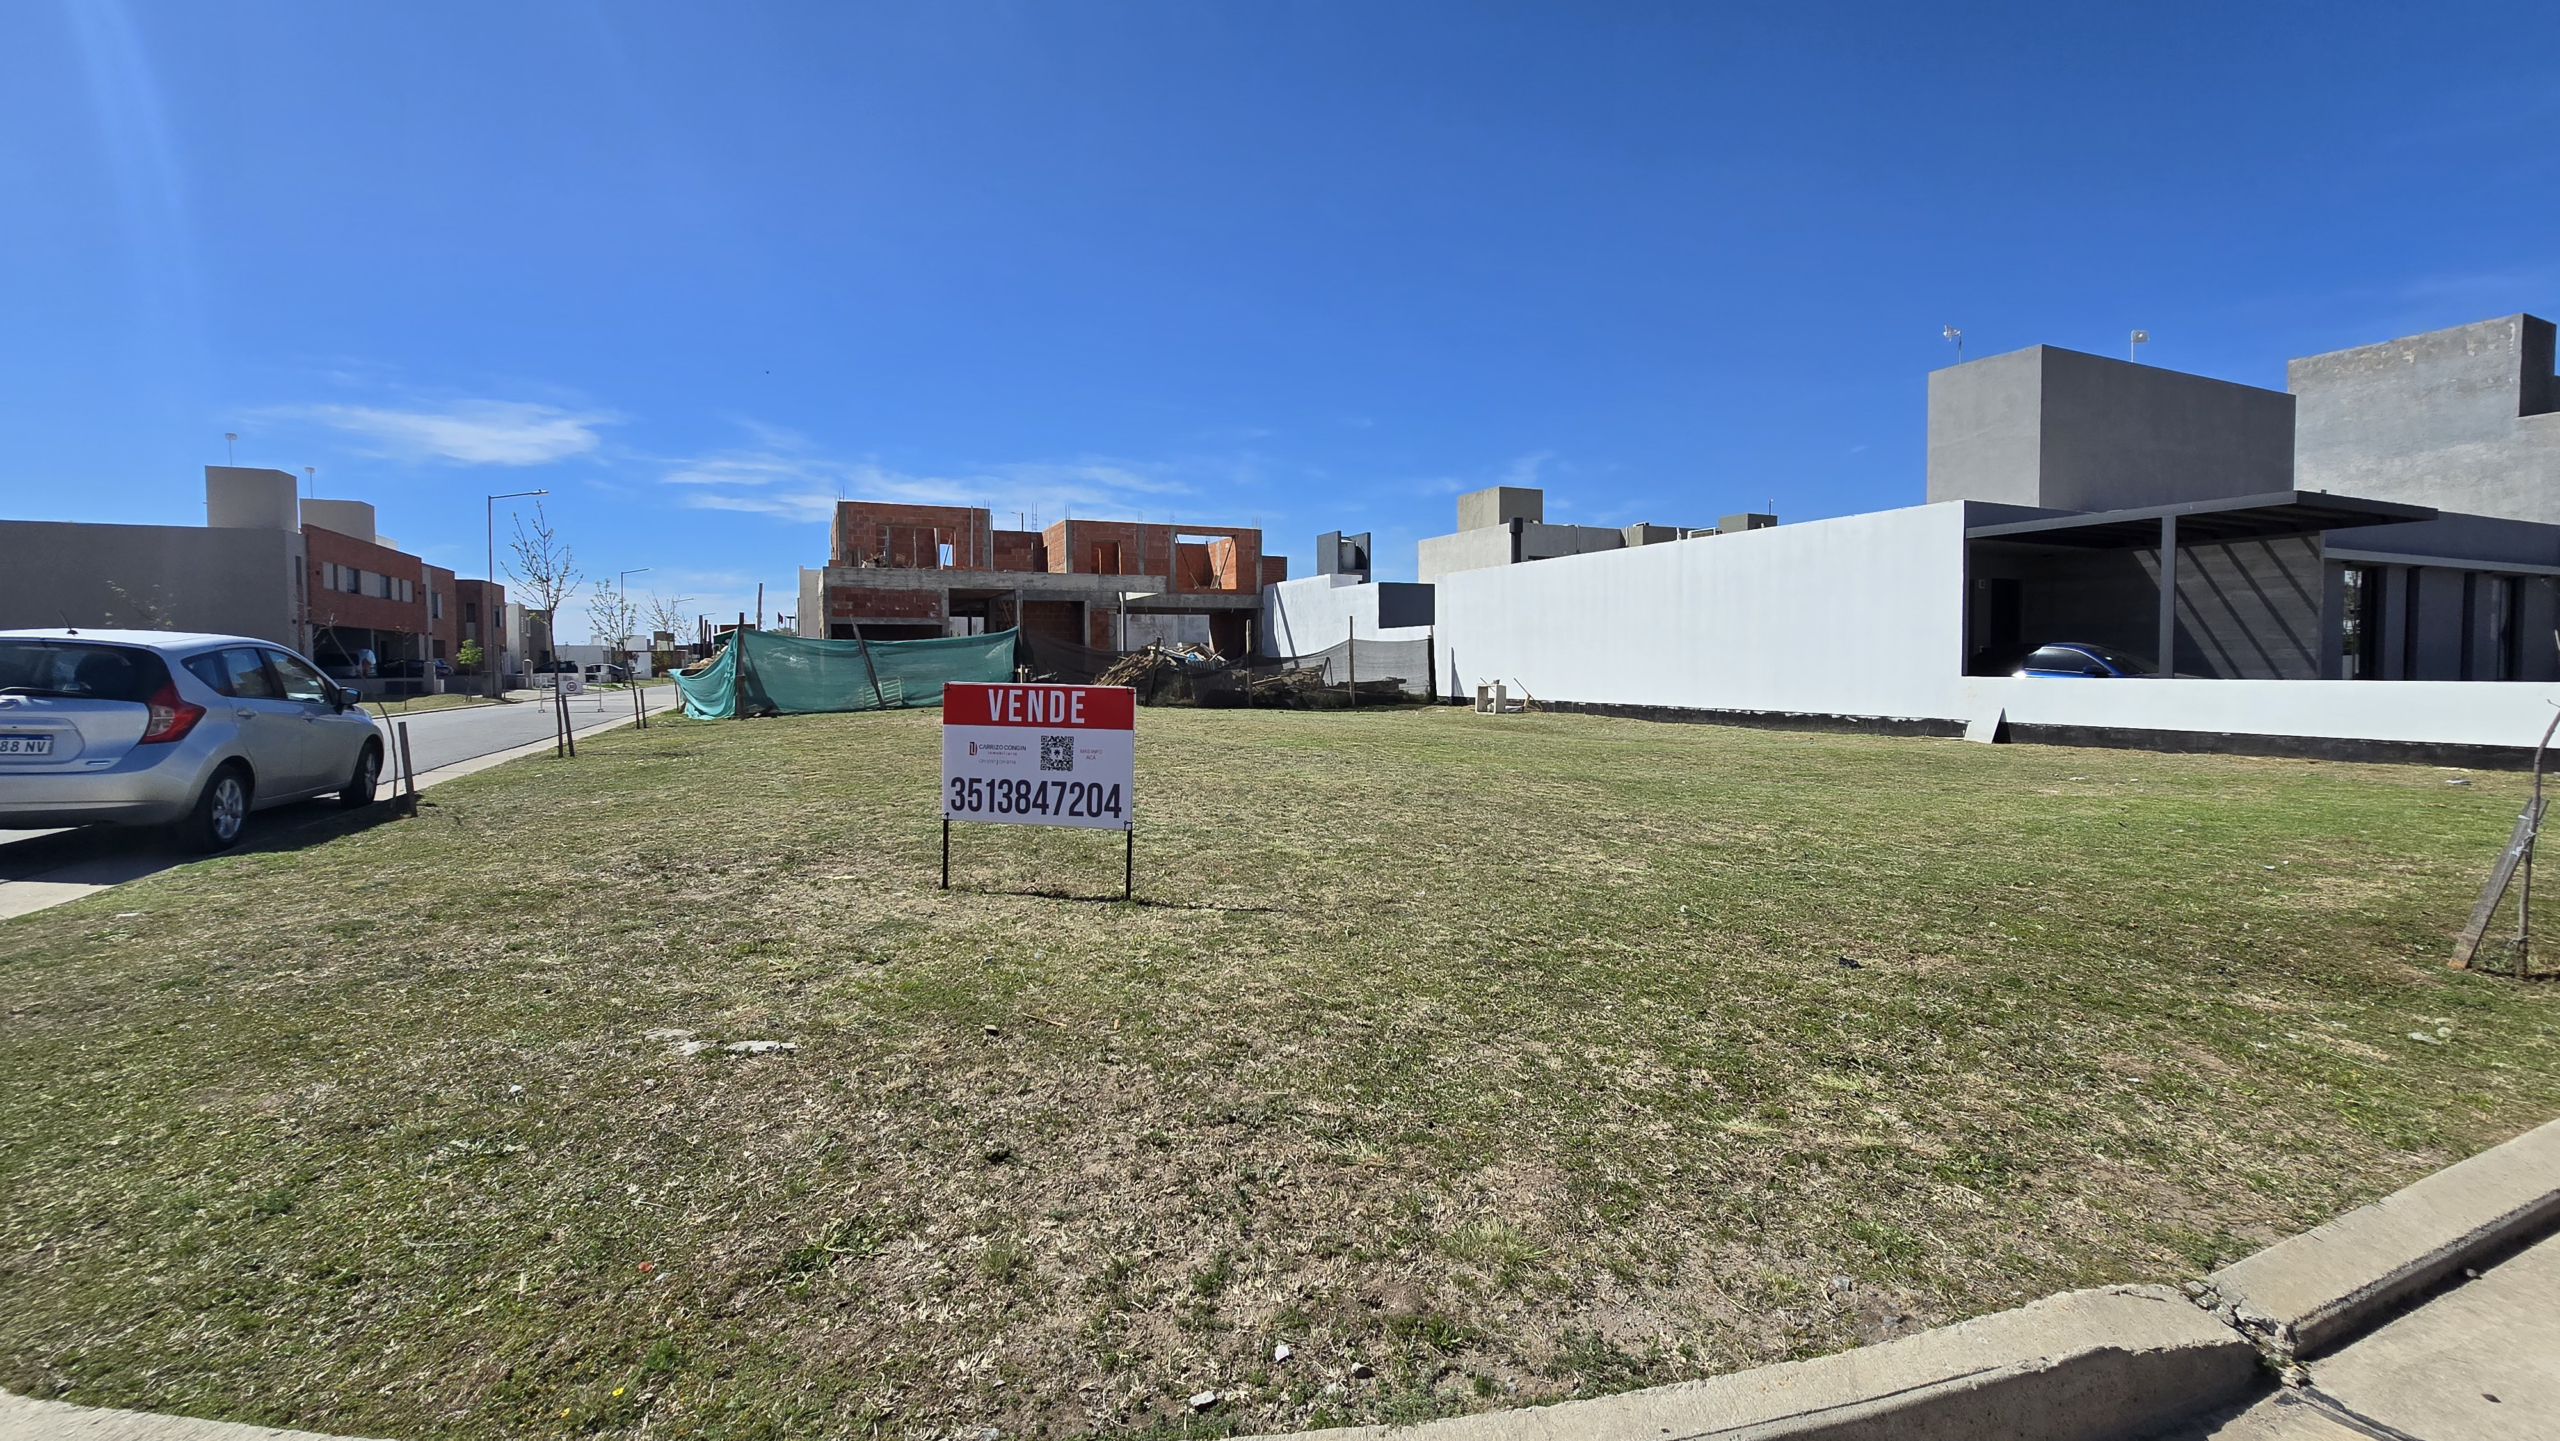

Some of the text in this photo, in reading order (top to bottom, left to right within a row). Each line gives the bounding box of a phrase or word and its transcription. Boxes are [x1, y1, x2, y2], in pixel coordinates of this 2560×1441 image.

[987, 688, 1086, 724] VENDE
[24, 741, 46, 752] NV
[950, 776, 1122, 819] 3513847204
